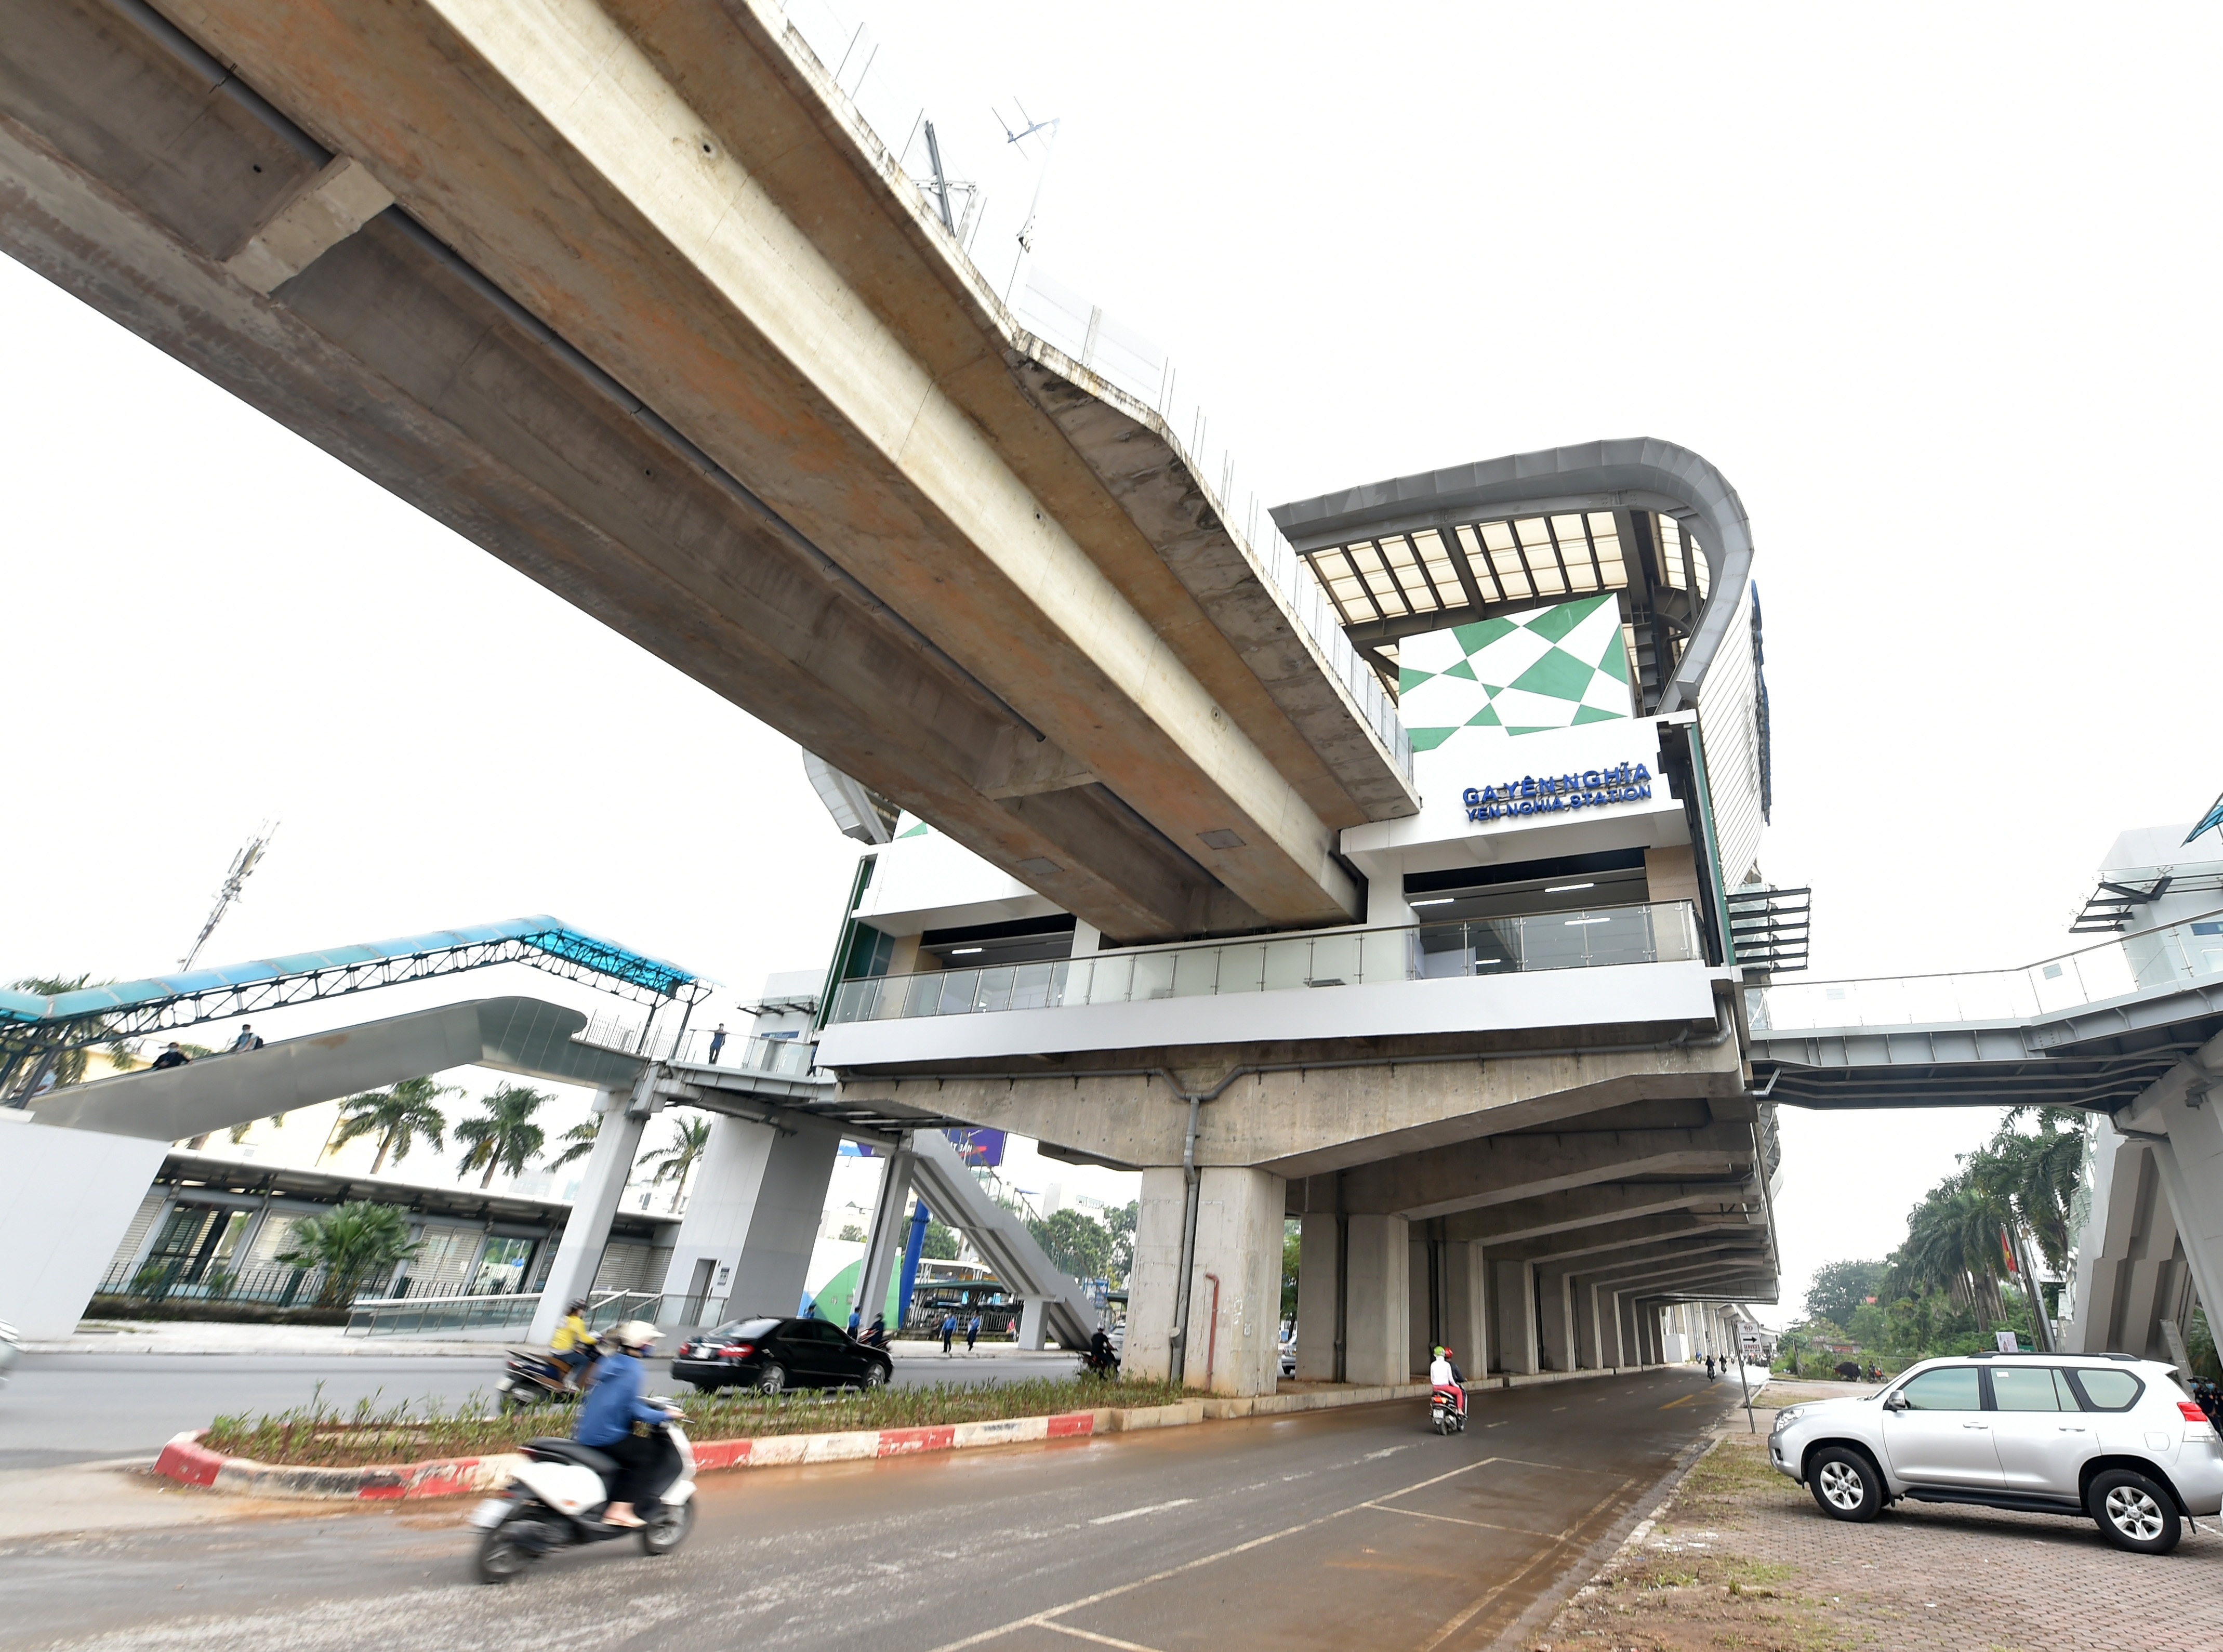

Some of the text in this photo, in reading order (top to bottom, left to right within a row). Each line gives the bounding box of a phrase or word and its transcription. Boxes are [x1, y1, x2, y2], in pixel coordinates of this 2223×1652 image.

[1463, 761, 1652, 804] GA YÊN NGHĨA
[1465, 785, 1651, 822] YEN NGHIA STATION
